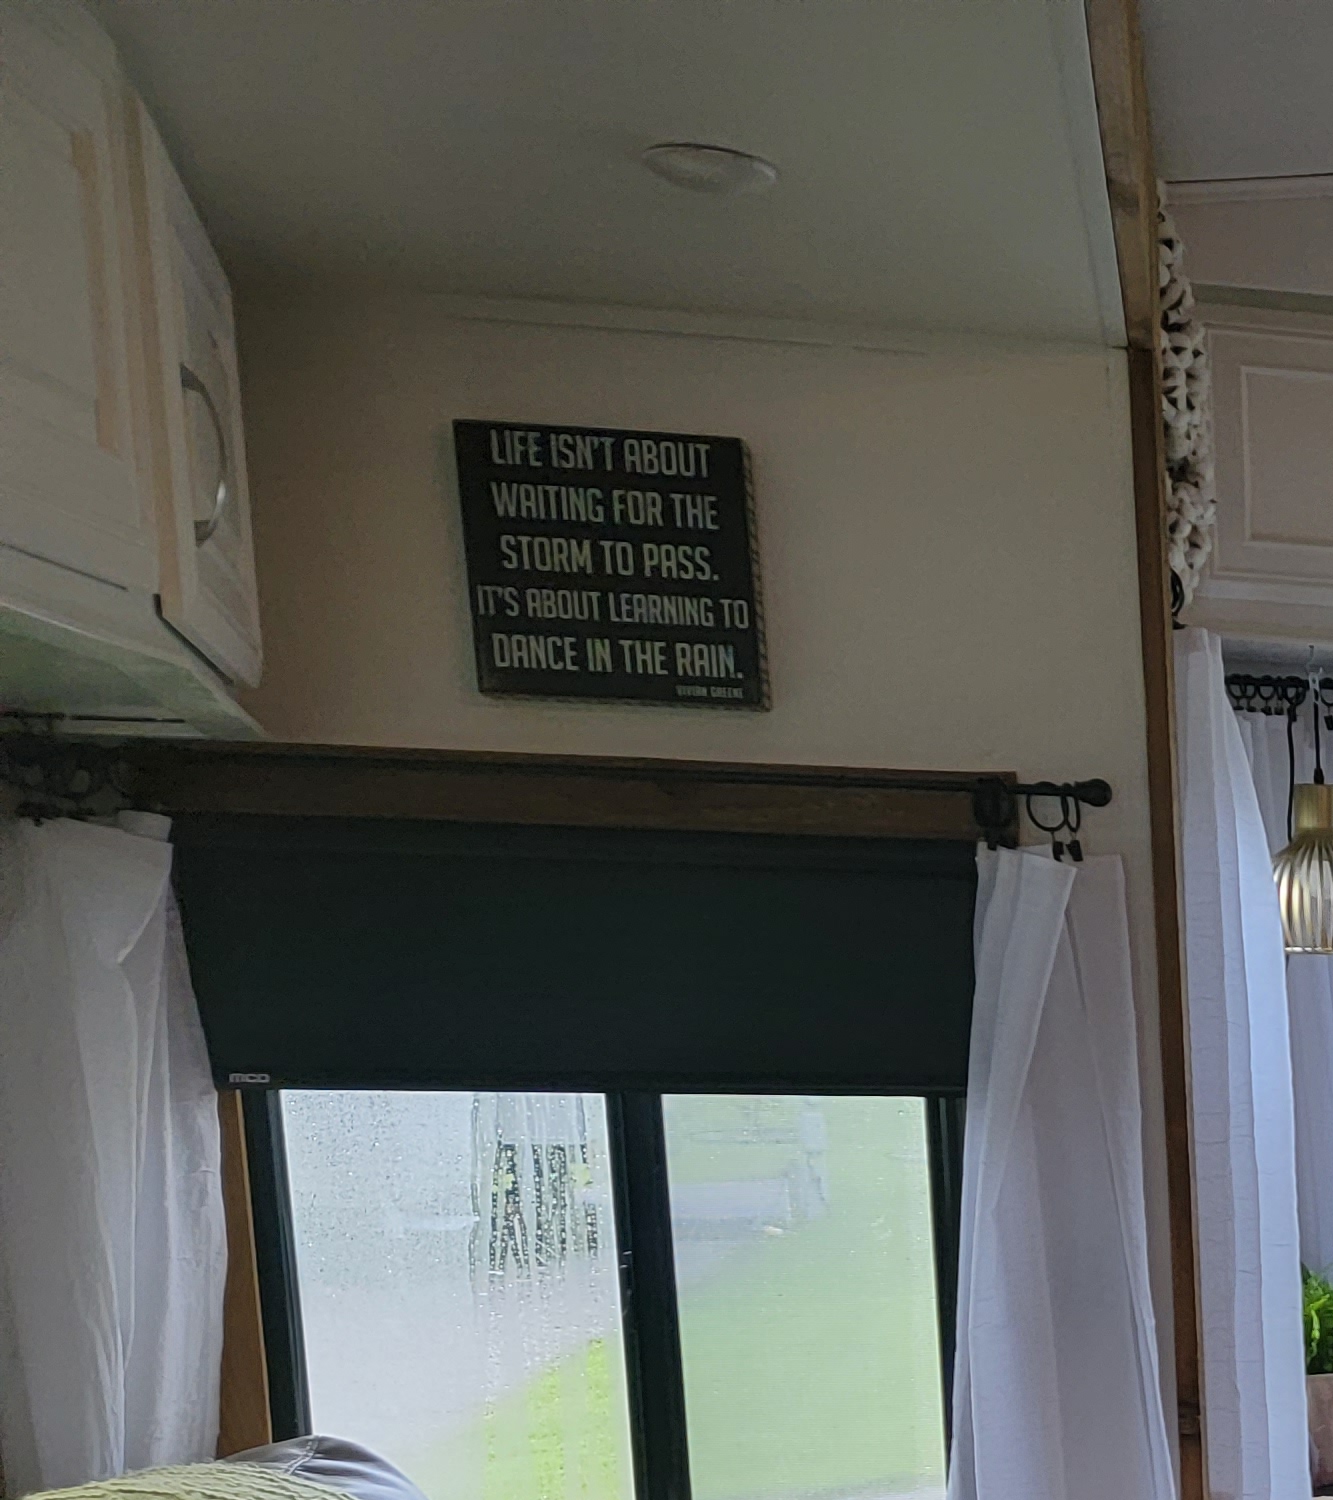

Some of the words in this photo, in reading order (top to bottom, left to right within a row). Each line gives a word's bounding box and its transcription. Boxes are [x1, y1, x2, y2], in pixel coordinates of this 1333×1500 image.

[489, 428, 543, 467] LIFE
[549, 432, 616, 471] ISN'T
[623, 438, 711, 478] ABOUT
[490, 481, 604, 523] WAITING
[611, 488, 664, 527] FOR
[669, 493, 720, 531] THE
[500, 534, 594, 575] STORM
[600, 539, 634, 577] TO
[642, 543, 720, 582] PASS.
[476, 584, 520, 618] IT'S
[525, 587, 602, 621] ABOUT
[608, 592, 715, 628] LEARNING
[719, 598, 749, 630] TO
[490, 632, 579, 672] DANCE
[586, 637, 612, 673] IN
[618, 639, 669, 676] THE
[675, 642, 744, 680] RAIN.
